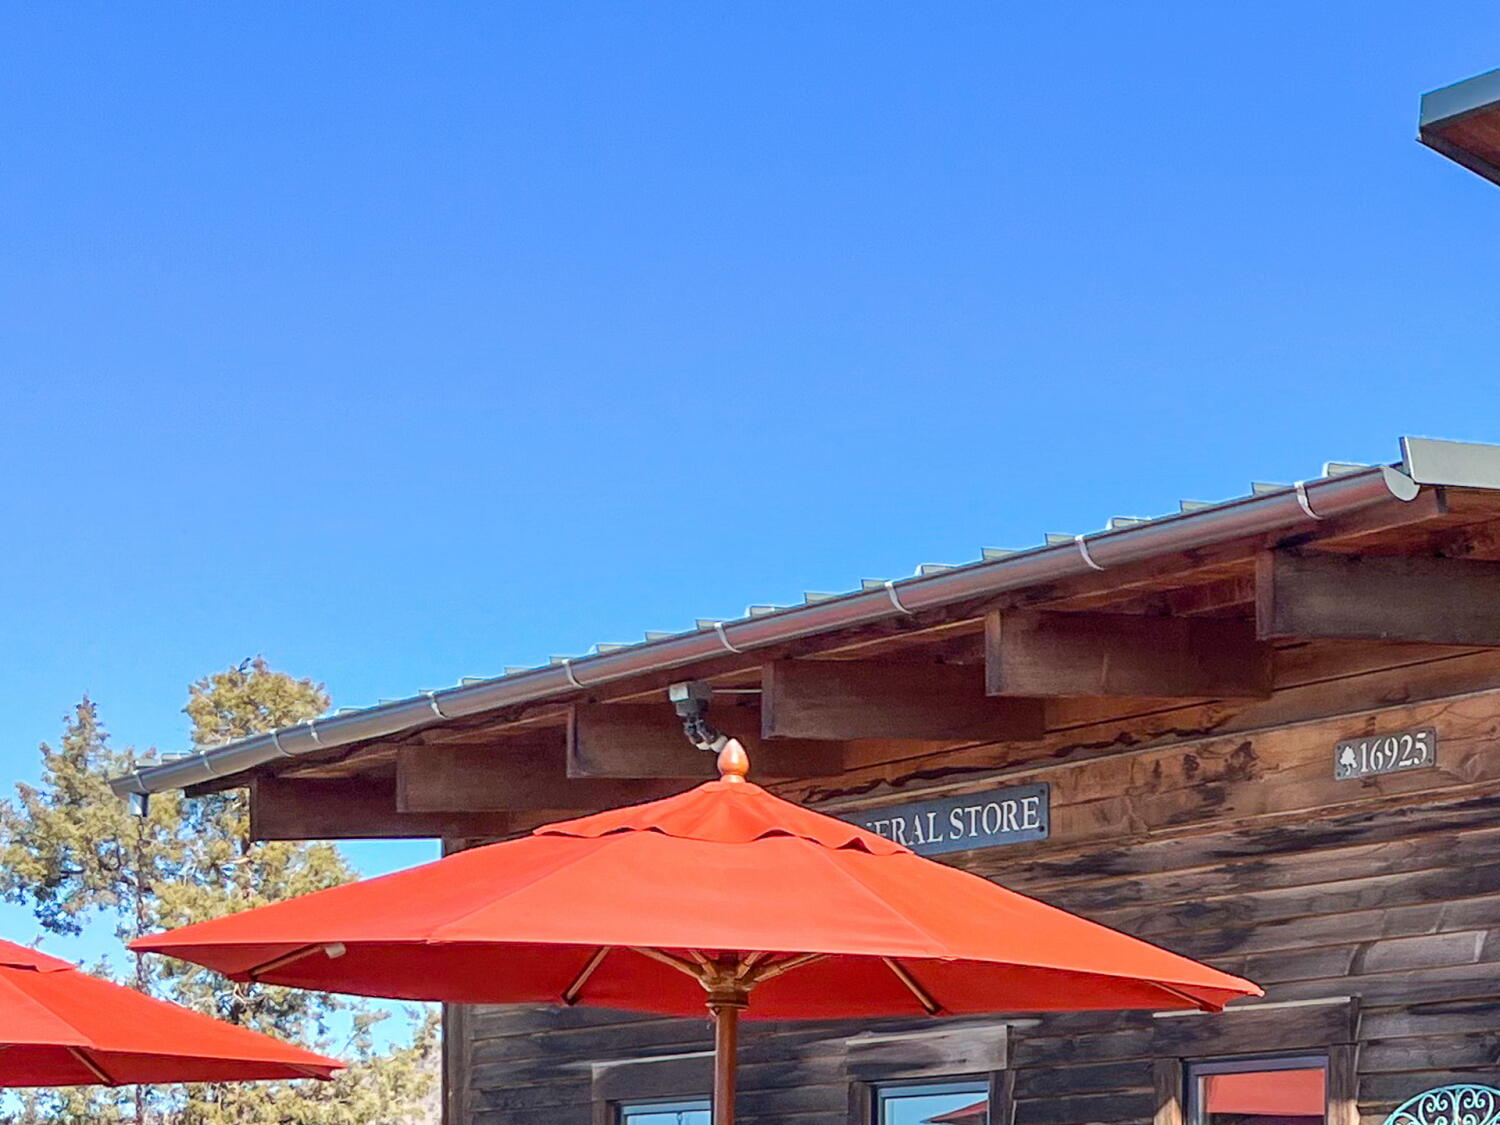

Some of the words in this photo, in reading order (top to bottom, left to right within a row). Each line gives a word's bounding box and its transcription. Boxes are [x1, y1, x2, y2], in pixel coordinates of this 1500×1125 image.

[1360, 732, 1427, 772] 16925
[866, 812, 943, 847] ERAL
[949, 797, 1041, 840] STORE
